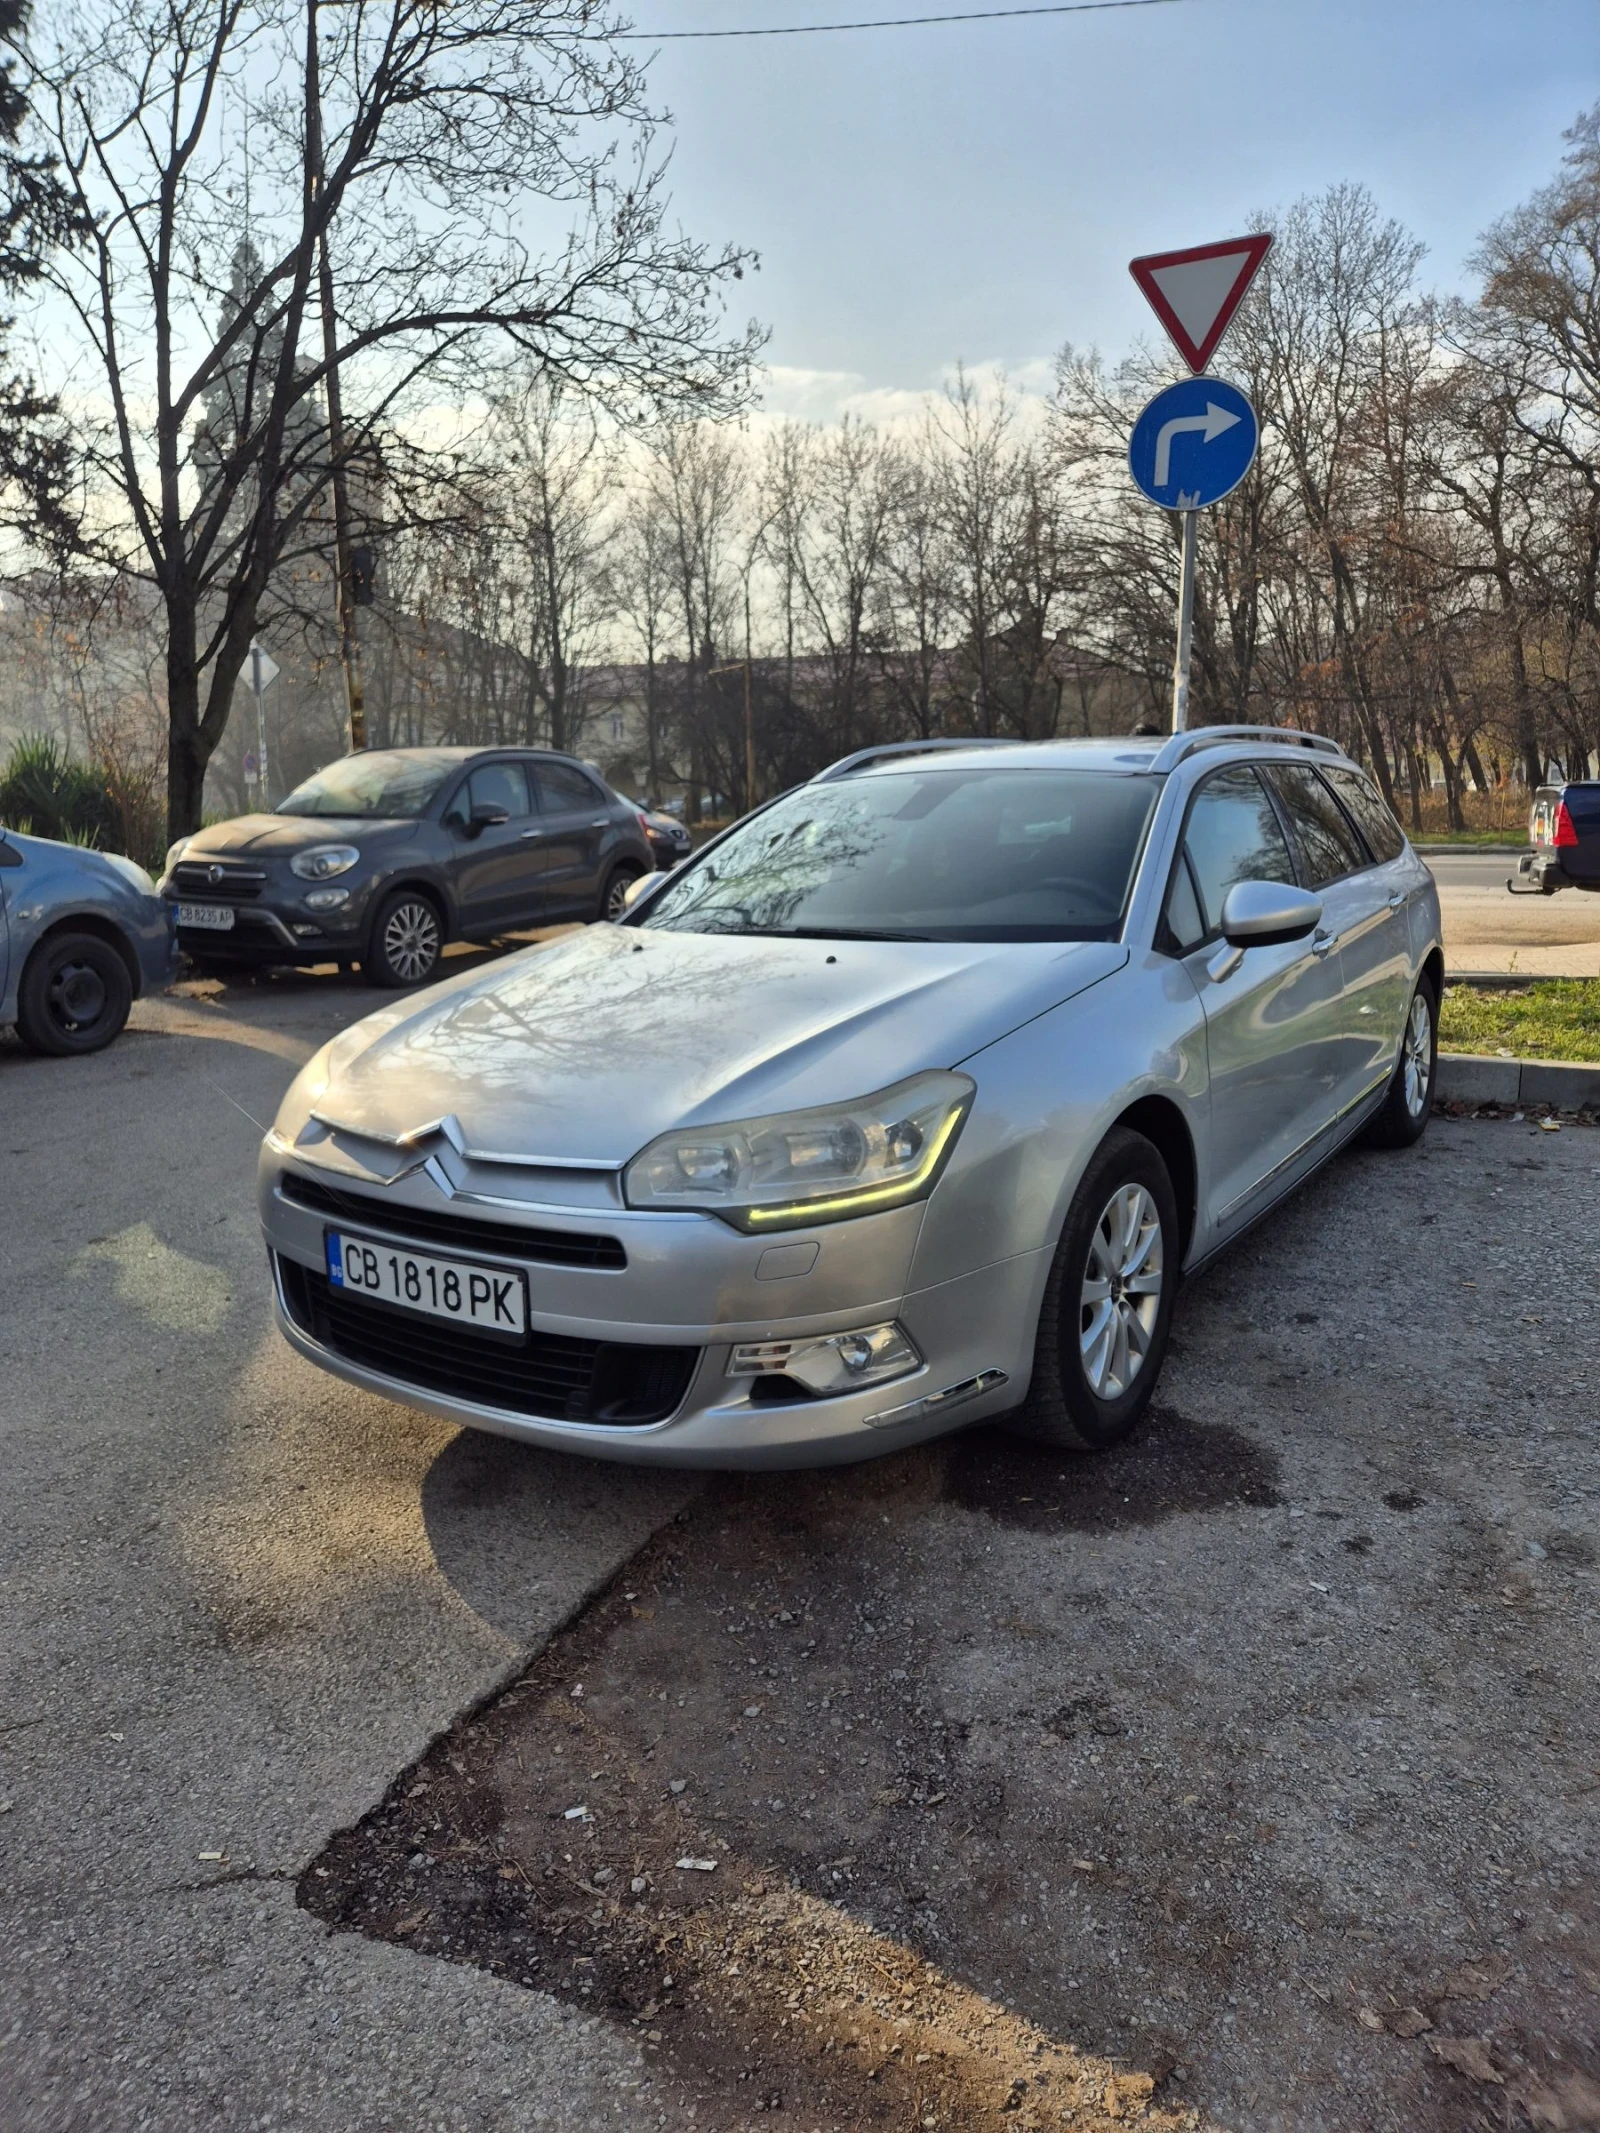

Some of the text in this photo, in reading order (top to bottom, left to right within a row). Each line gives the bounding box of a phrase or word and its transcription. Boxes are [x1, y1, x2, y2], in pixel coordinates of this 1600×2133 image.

[331, 1263, 343, 1279] BG
[345, 1244, 516, 1325] CB 1818 PK
